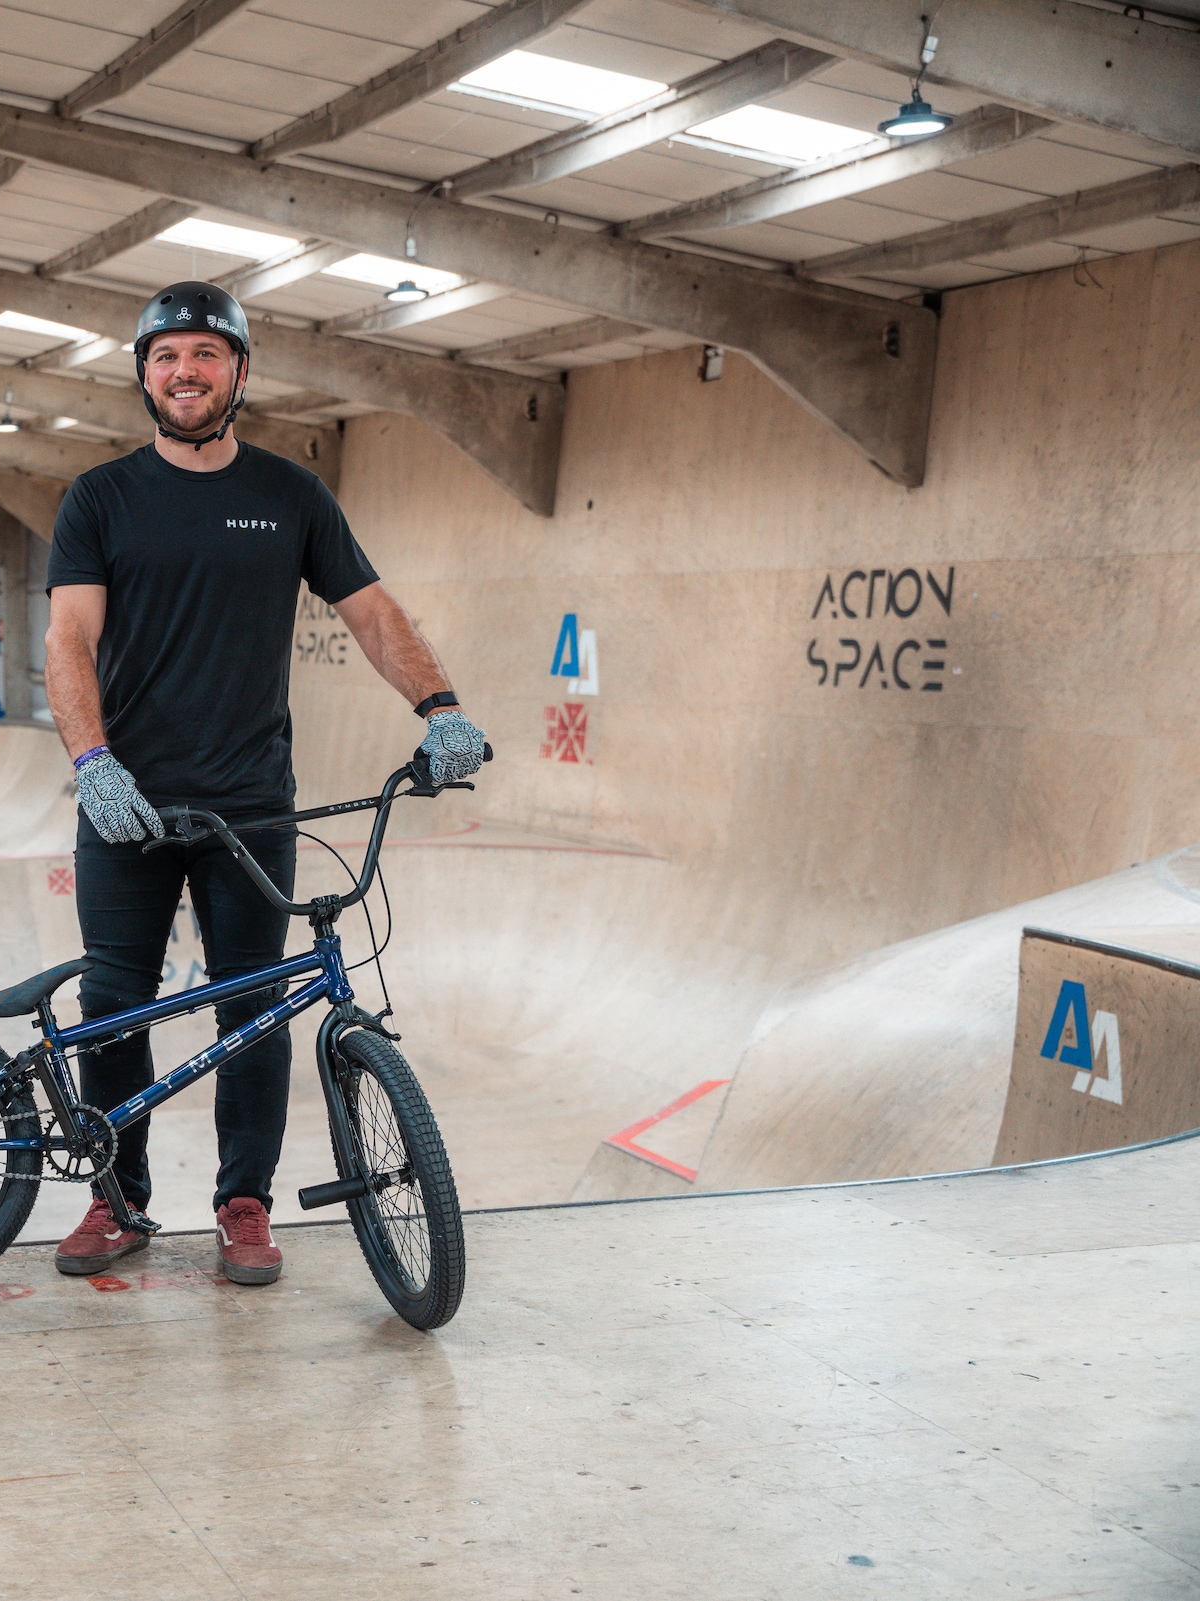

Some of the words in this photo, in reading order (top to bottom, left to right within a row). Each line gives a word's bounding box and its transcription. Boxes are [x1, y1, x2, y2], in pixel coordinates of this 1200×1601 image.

[216, 321, 239, 335] BRUCE
[226, 518, 278, 531] HUFFY
[811, 566, 955, 620] ACTION
[296, 632, 348, 665] SPACE
[807, 638, 947, 691] SPACE
[329, 799, 375, 811] SYMBOL
